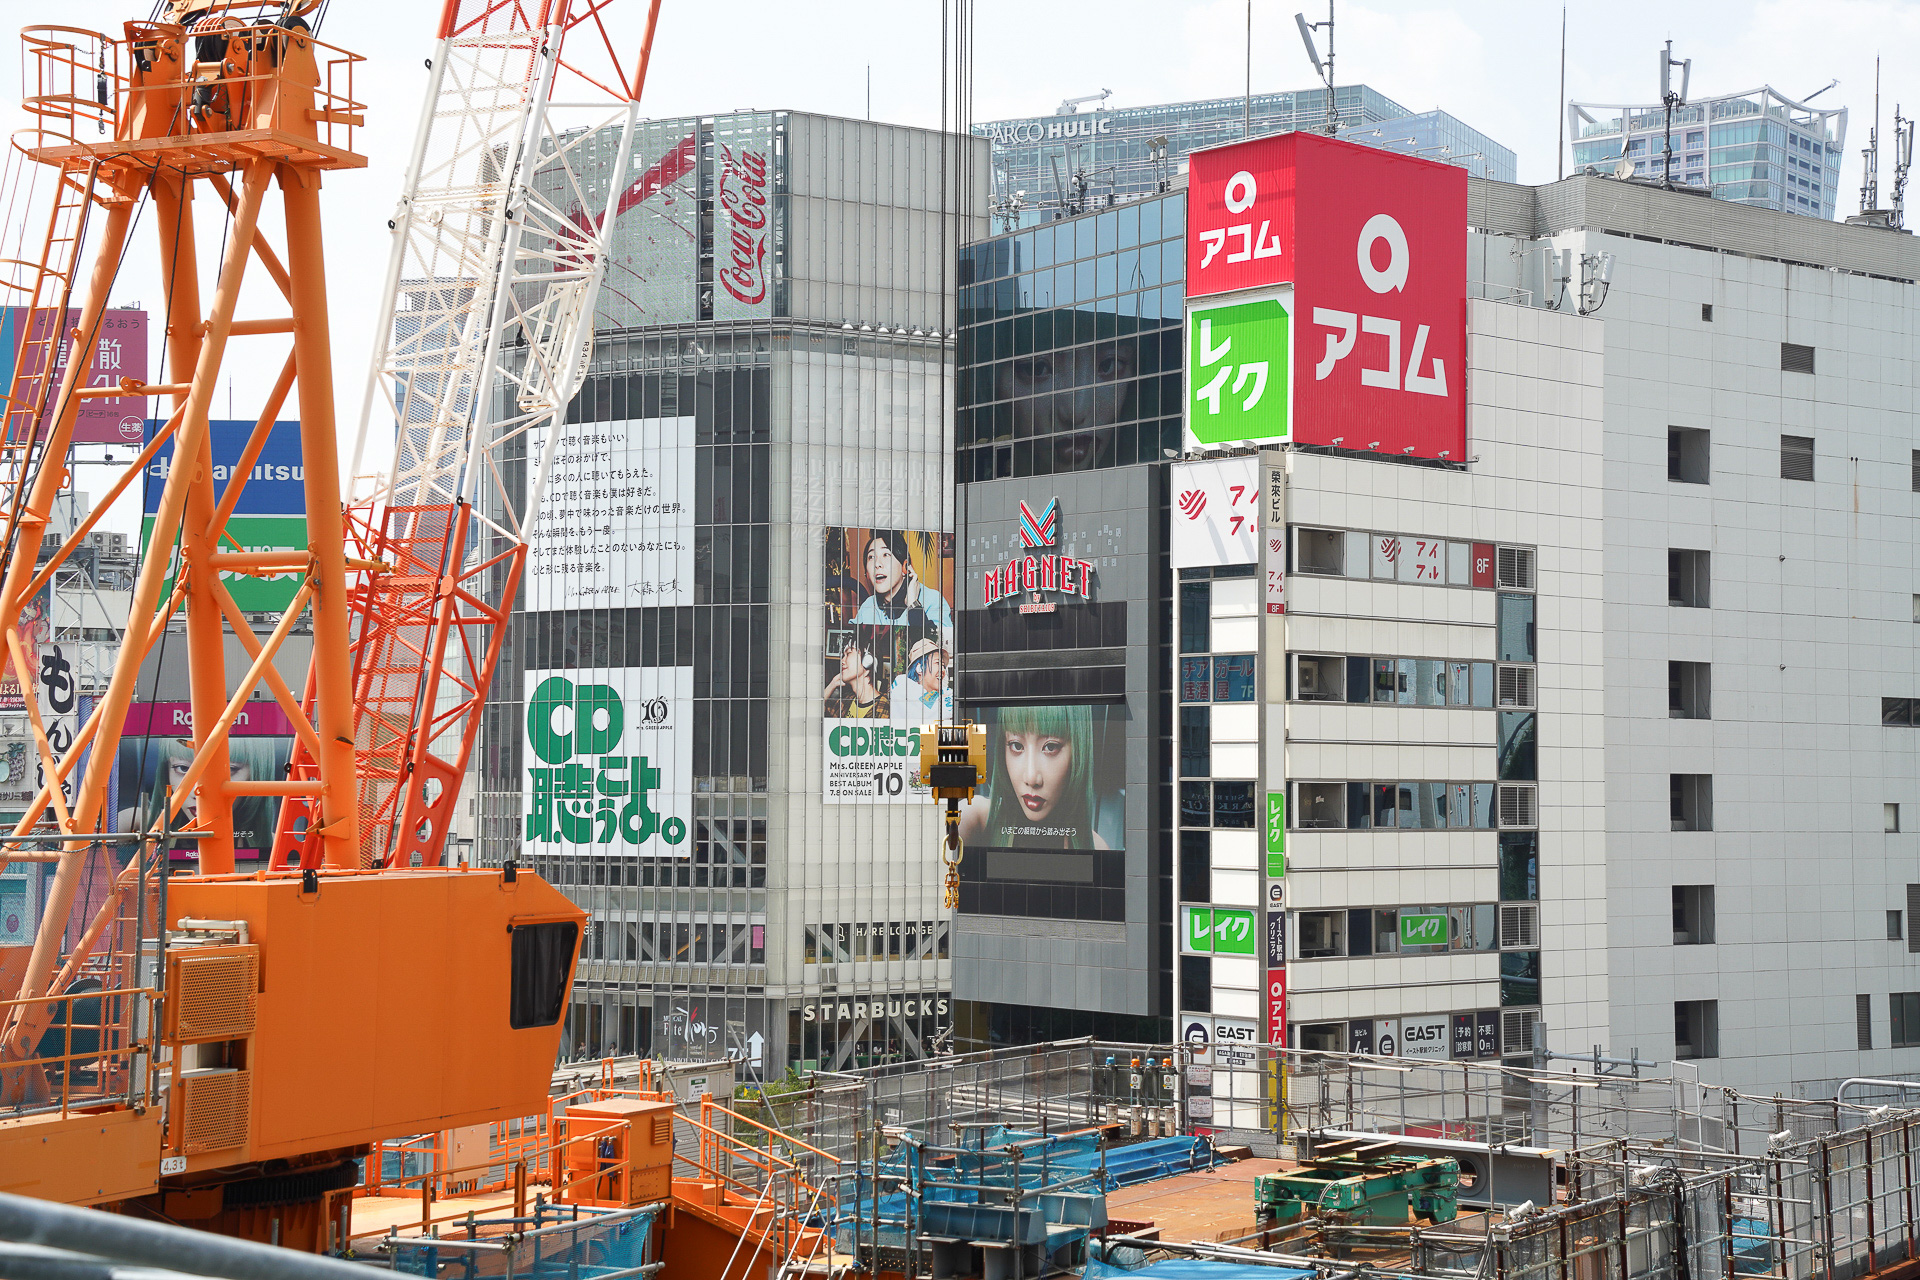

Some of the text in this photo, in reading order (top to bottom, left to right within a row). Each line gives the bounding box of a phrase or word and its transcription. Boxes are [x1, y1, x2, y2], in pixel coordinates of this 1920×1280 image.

[984, 117, 1112, 145] PARCO HULIC
[719, 141, 767, 305] Coca-Cola
[1199, 219, 1283, 270] アコム
[1312, 305, 1449, 398] アコム
[120, 423, 142, 433] 生薬
[1476, 558, 1490, 574] 8F
[984, 554, 1094, 607] MAGNET
[1033, 592, 1041, 602] by
[1271, 604, 1280, 613] 8F
[1183, 659, 1254, 679] チアガール
[1183, 681, 1254, 701] 居酒屋 7F
[527, 676, 624, 765] CD
[830, 762, 903, 770] Mrs. GREEN APPLE
[873, 772, 904, 796] 10
[1269, 800, 1281, 843] レイク
[1193, 914, 1250, 942] レイク
[1406, 918, 1440, 938] レイク
[803, 999, 949, 1022] STARBUCKS
[1217, 1026, 1255, 1041] EAST
[1271, 1001, 1282, 1046] アコム
[1405, 1025, 1446, 1042] EAST
[1406, 1045, 1445, 1055] イースト駅前クリニック
